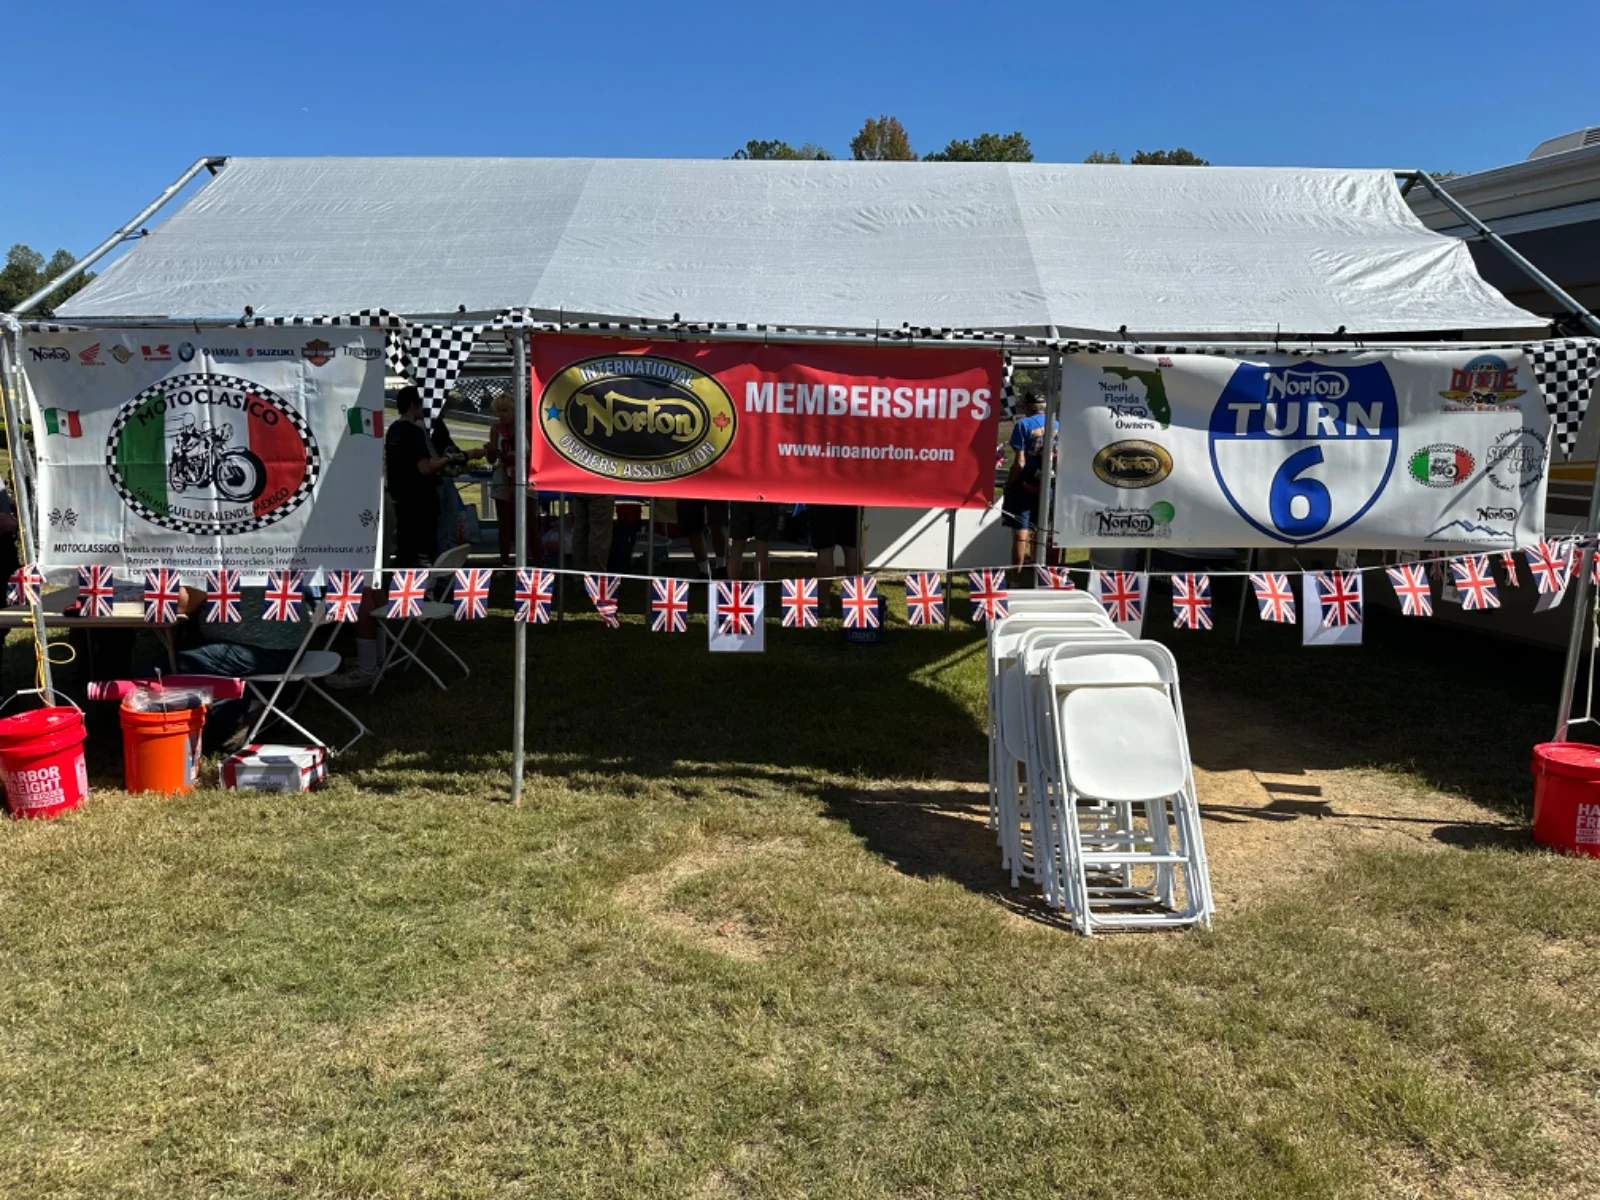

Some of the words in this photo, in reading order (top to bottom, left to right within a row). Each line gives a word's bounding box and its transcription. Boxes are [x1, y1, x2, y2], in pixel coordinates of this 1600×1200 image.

[28, 346, 71, 363] Norton
[256, 348, 295, 357] SUZUKI
[579, 359, 694, 389] INTERNATIONAL
[1263, 369, 1350, 400] Norton
[1449, 366, 1519, 392] DIXIE
[1097, 381, 1128, 392] North
[136, 388, 279, 427] MOTOCLASICO
[745, 381, 992, 421] MEMBERSHIPS
[1104, 392, 1140, 404] Florida
[575, 390, 704, 443] Norton
[1107, 404, 1148, 420] Norton
[1227, 401, 1384, 437] TURN
[1115, 419, 1155, 430] Owners
[560, 434, 618, 475] OWNERS
[622, 441, 717, 478] ASSOCIATION
[777, 441, 955, 462] www.inoanorton.com
[1269, 443, 1333, 537] 6
[136, 486, 154, 504] SAN
[154, 499, 192, 519] MIGUEL
[193, 510, 207, 521] DE
[253, 486, 290, 513] MEXICO
[1476, 505, 1518, 521] Norton
[1095, 511, 1155, 533] Norton
[53, 543, 120, 554] MOTOCLASSICO
[124, 546, 149, 554] meets
[151, 546, 174, 556] every
[175, 545, 225, 556] Wednesday
[234, 546, 250, 555] the
[250, 546, 273, 557] Long
[275, 545, 298, 554] Horn
[299, 545, 354, 555] Smokehouse
[127, 557, 160, 568] Anyone
[161, 557, 203, 566] interested
[203, 557, 212, 566] in
[213, 557, 266, 568] motorcycles
[266, 558, 274, 566] is
